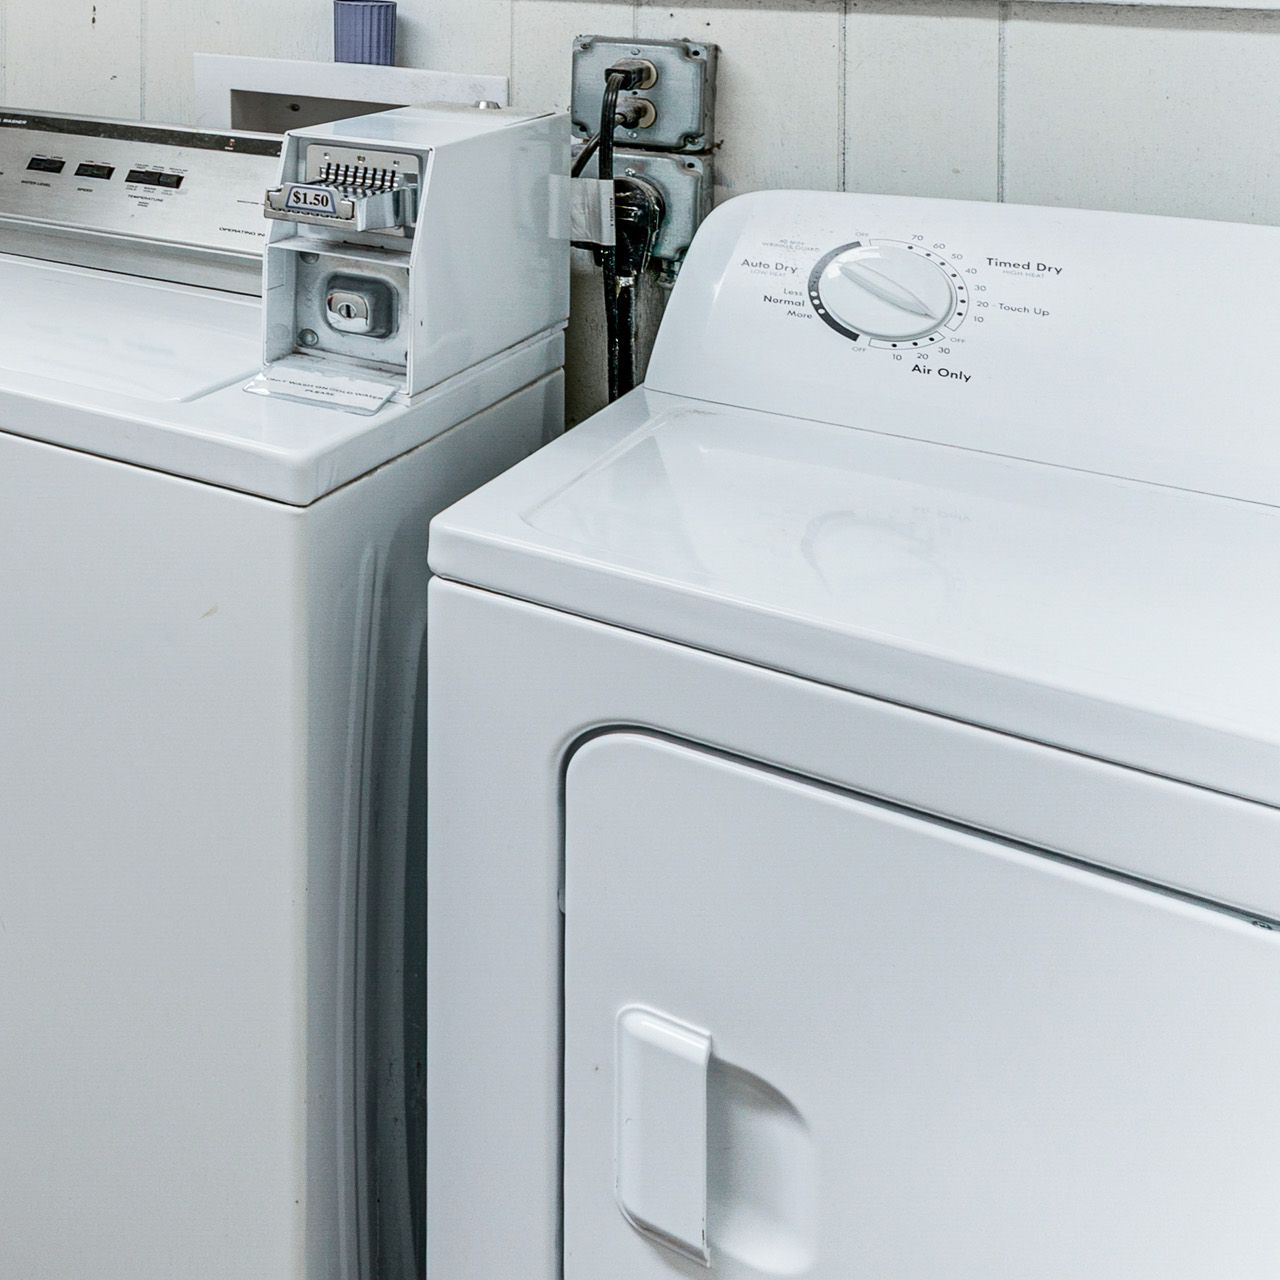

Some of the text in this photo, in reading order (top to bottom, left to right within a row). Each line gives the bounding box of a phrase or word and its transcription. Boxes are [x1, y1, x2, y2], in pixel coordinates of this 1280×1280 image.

[292, 190, 329, 208] $1.50
[741, 258, 798, 273] Auto Dry
[965, 267, 977, 275] 40
[986, 257, 1063, 275] Timed Dry
[783, 288, 803, 296] Less
[763, 295, 805, 307] Normal
[786, 310, 813, 319] More
[998, 303, 1029, 313] Touch
[1033, 307, 1050, 317] Up
[911, 364, 972, 383] Air Only
[304, 388, 335, 396] PLEASE
